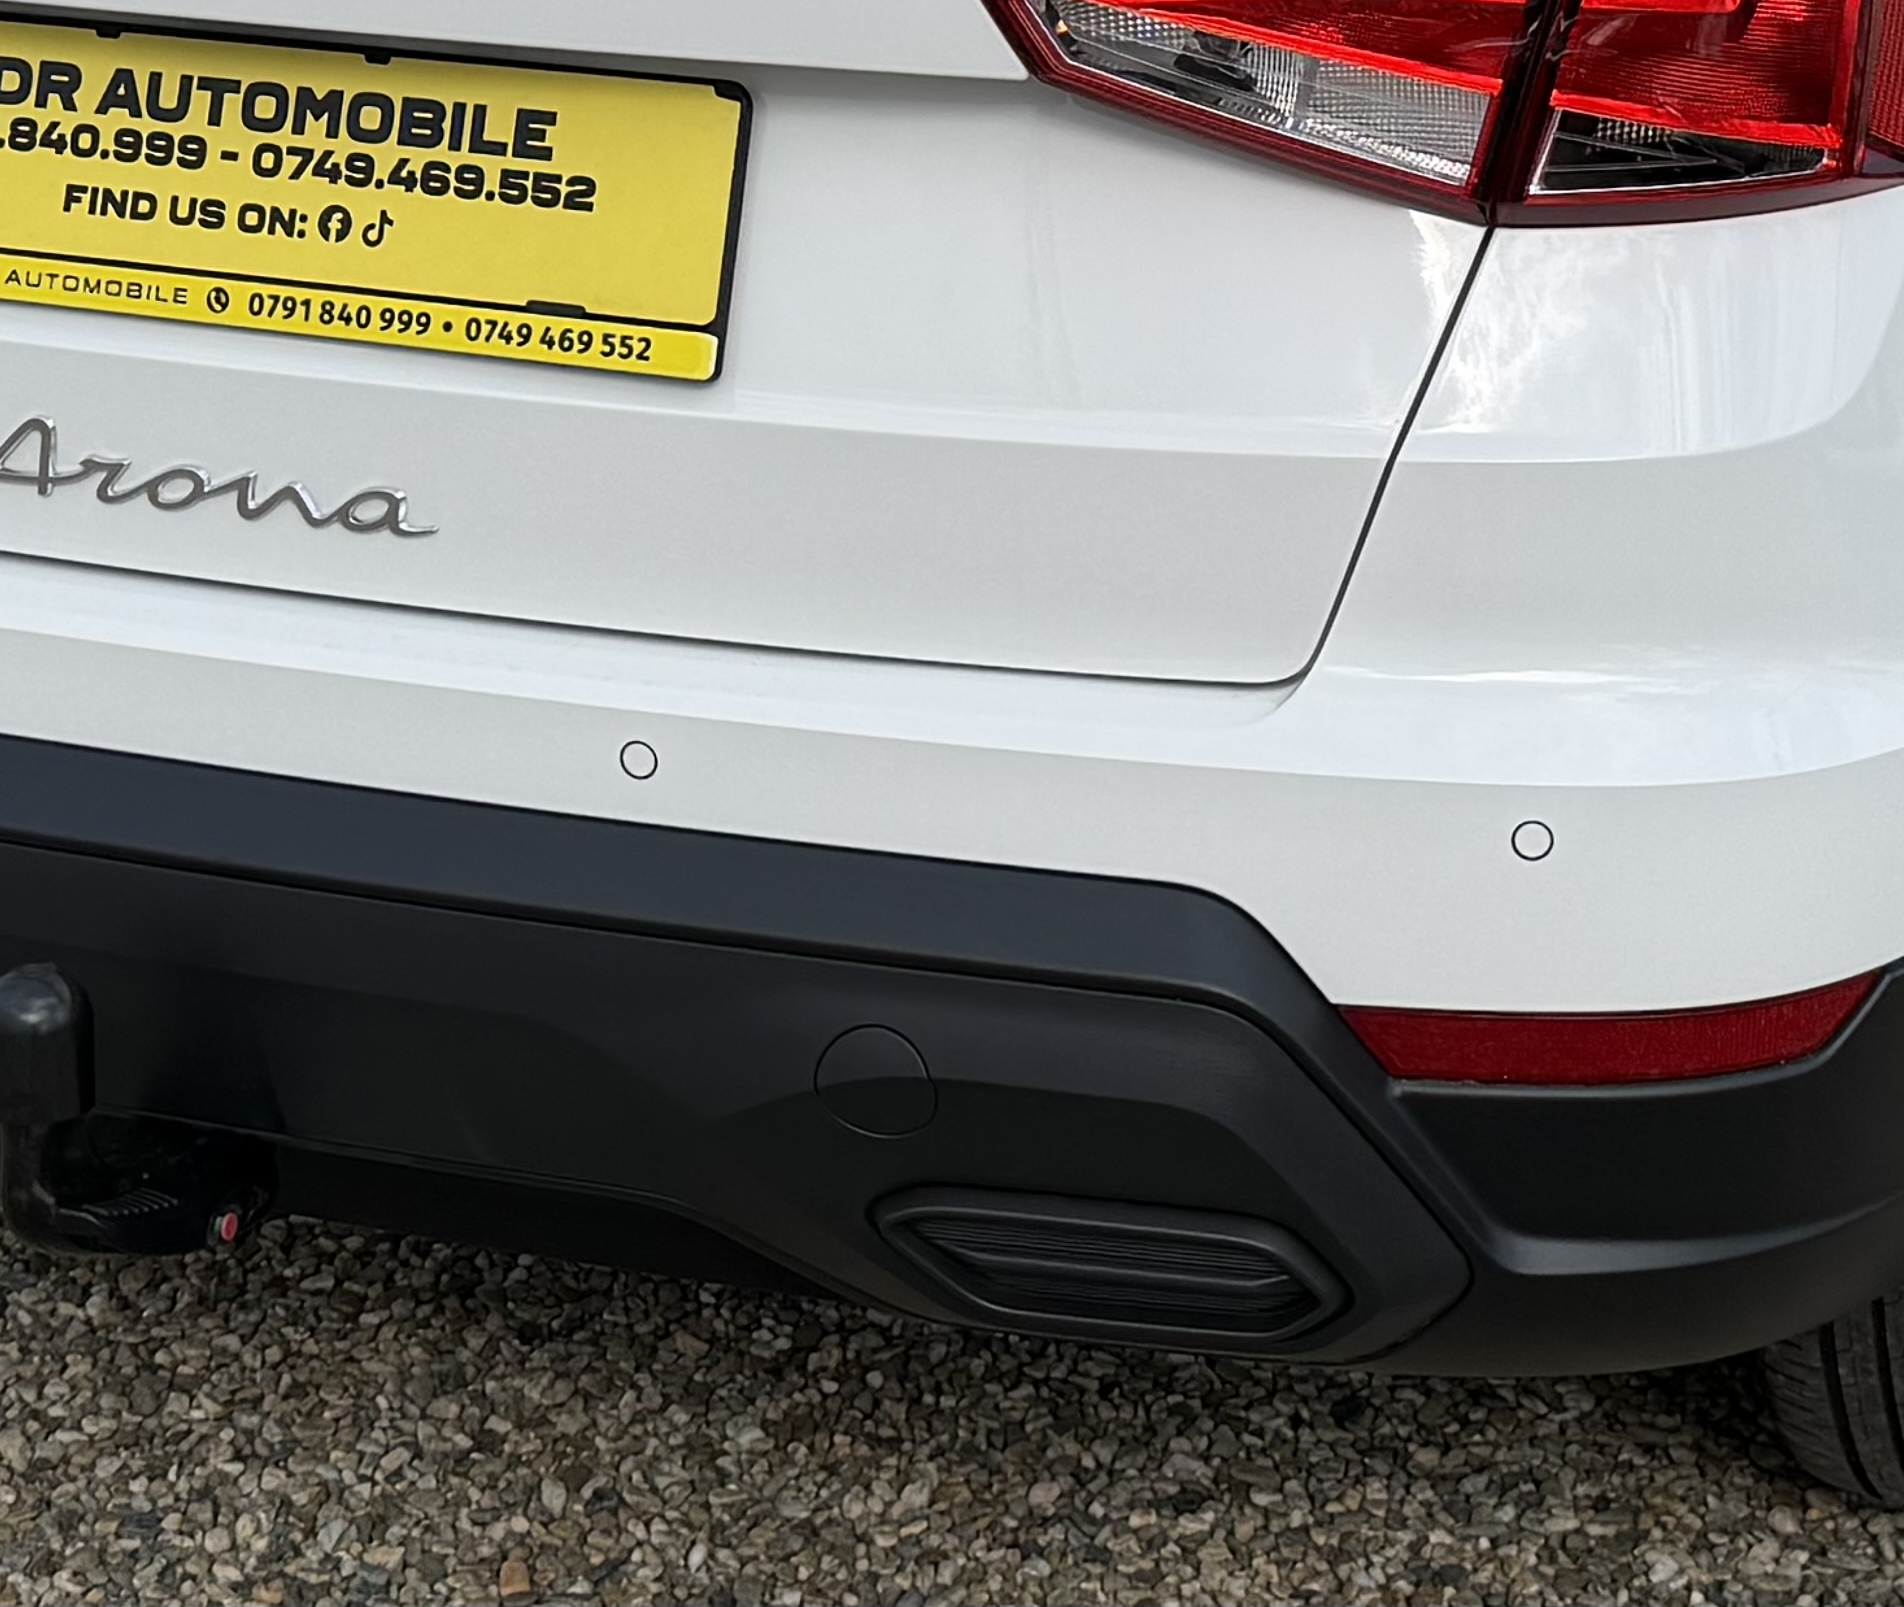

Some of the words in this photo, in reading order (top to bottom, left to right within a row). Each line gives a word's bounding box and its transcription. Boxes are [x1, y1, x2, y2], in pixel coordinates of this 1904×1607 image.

[94, 67, 558, 162] AUTOMOBILE
[62, 183, 158, 221] FIND
[168, 195, 226, 230] US
[237, 202, 308, 239] ON:
[252, 142, 597, 213] 0749.469.552
[4, 268, 189, 305] AUTOMOBILE
[248, 292, 311, 323] 0791
[319, 299, 371, 329] 840
[379, 310, 431, 336] 999
[464, 316, 532, 348] 0749
[539, 325, 593, 355] 469
[600, 334, 651, 362] 552
